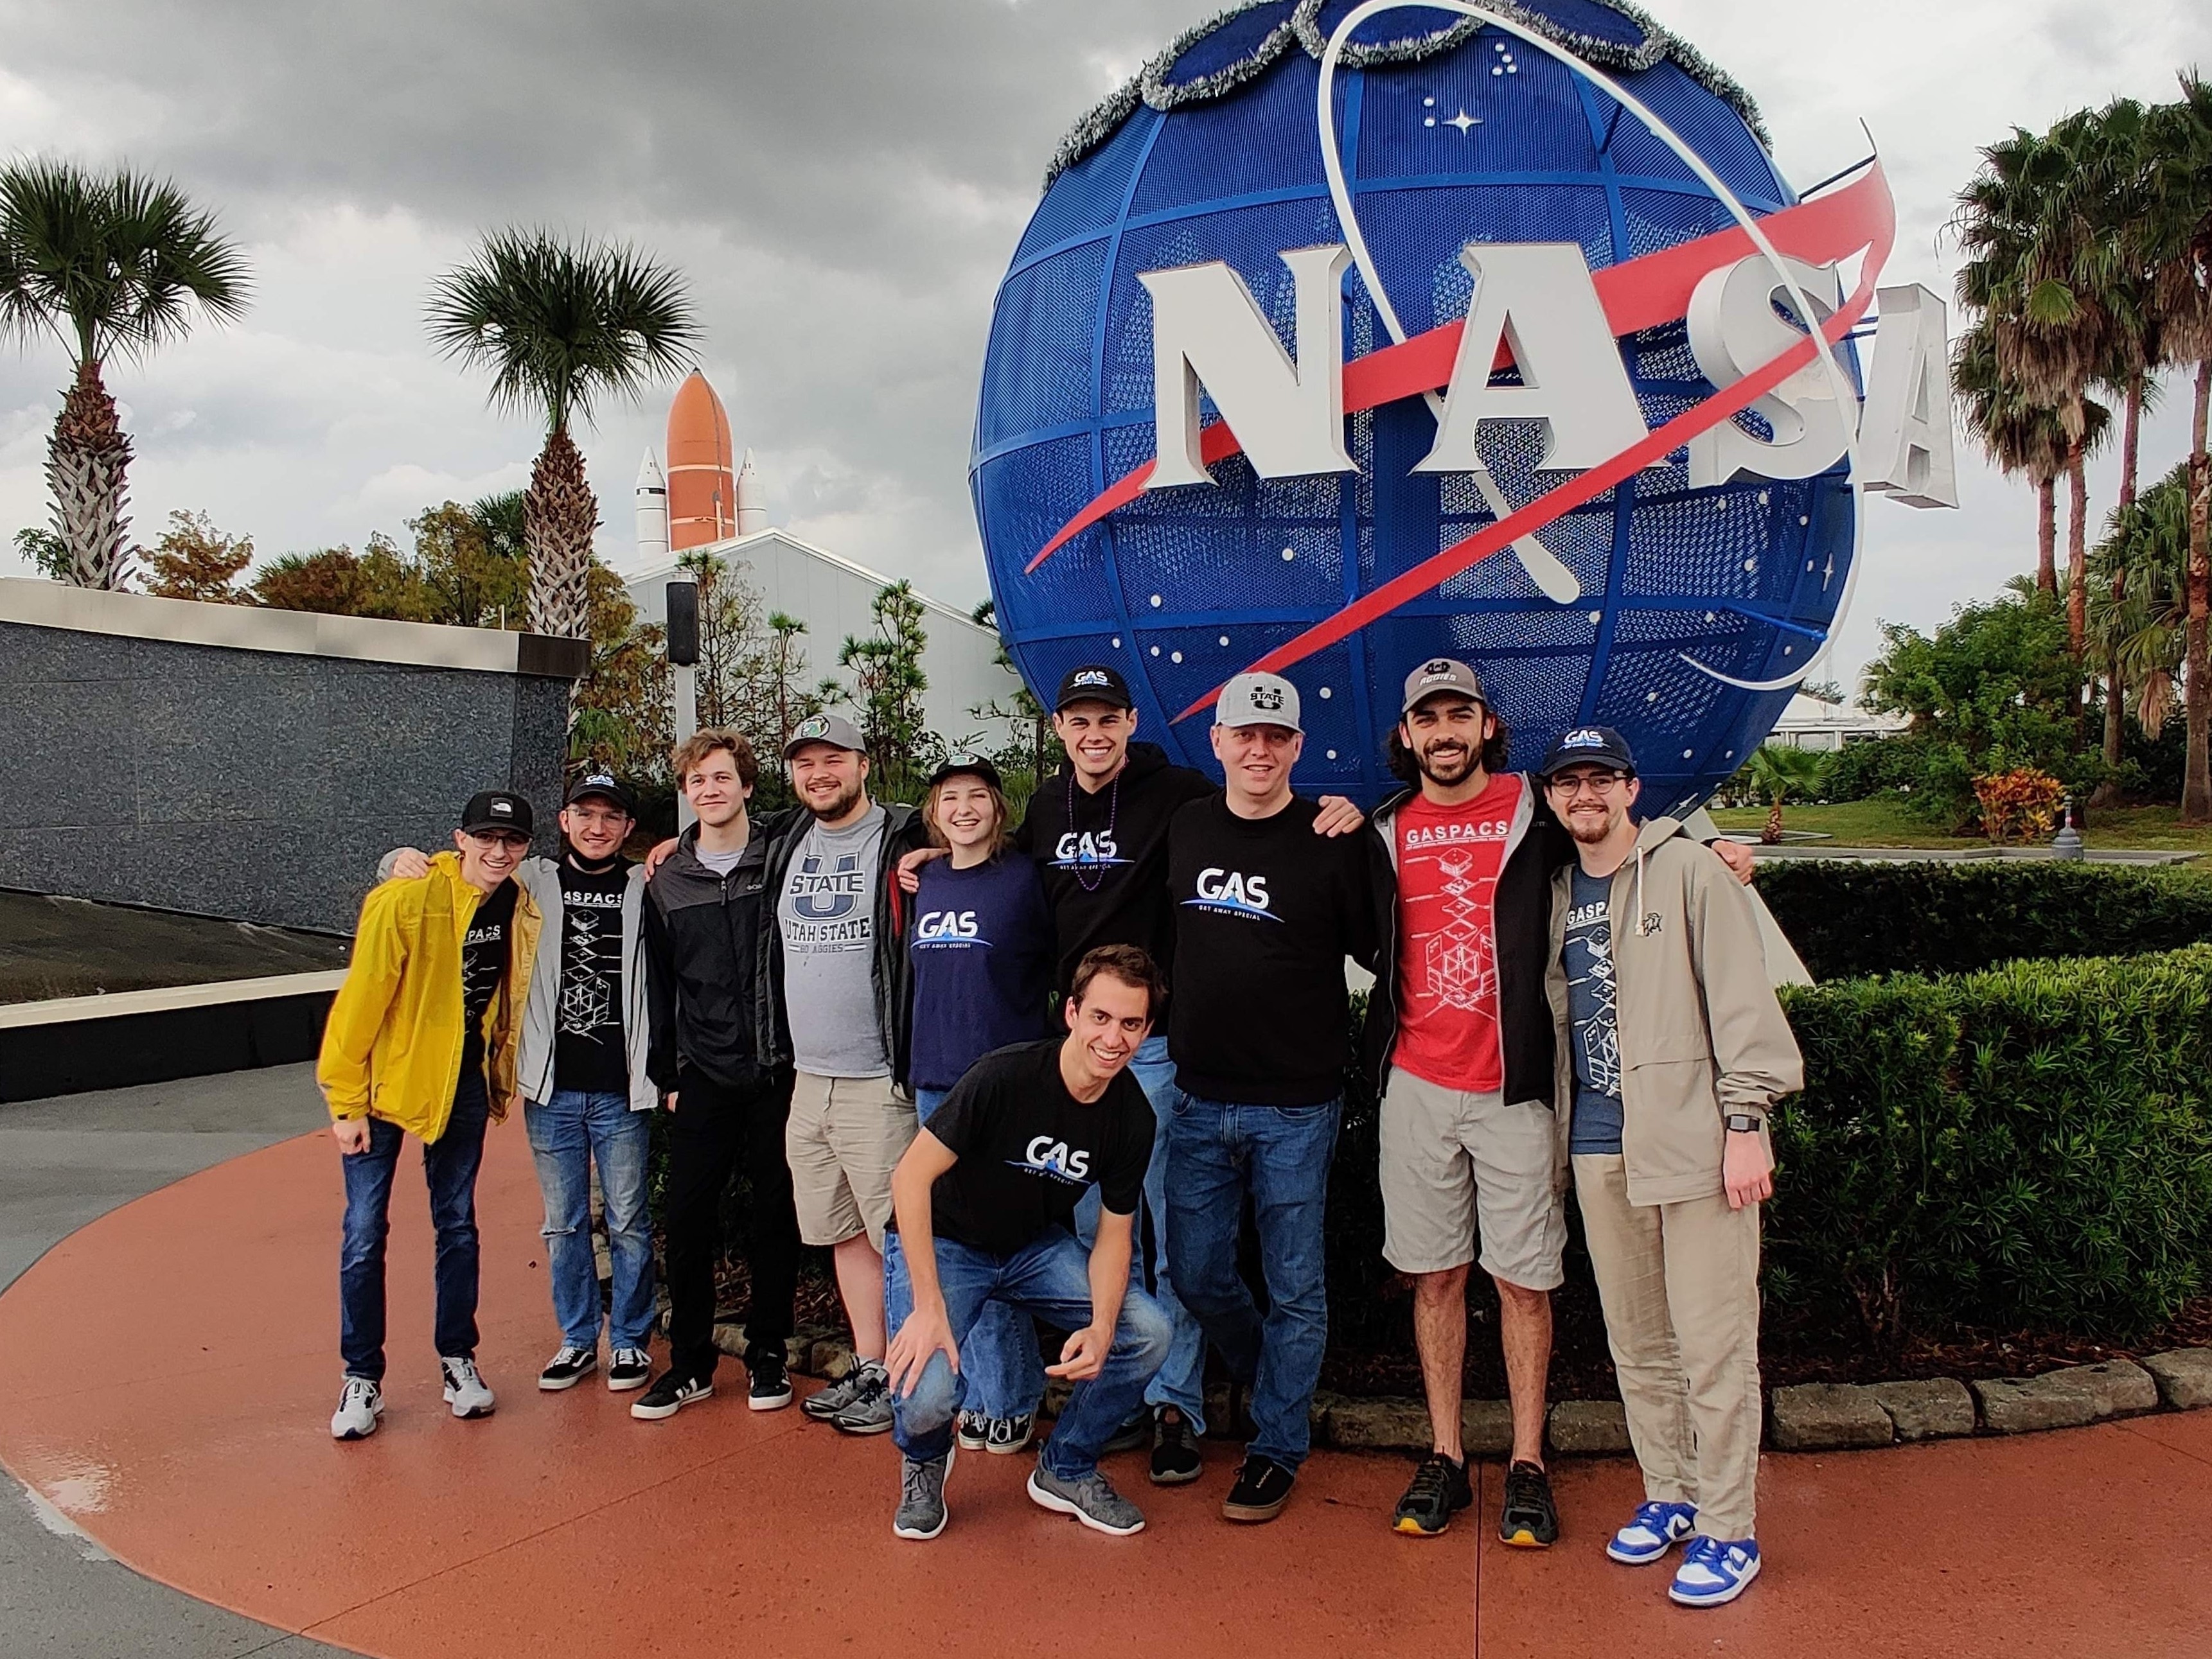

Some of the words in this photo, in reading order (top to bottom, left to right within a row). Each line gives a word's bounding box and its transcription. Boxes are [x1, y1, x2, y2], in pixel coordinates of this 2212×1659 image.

[1137, 241, 1958, 509] NASA
[1074, 671, 1108, 682] GAS
[1250, 692, 1284, 705] STATE
[1564, 730, 1604, 744] GAS
[1055, 829, 1117, 859] GAS
[1406, 820, 1508, 844] GASPACS
[790, 872, 864, 895] STATE
[1197, 868, 1270, 909] GAS
[563, 891, 623, 904] ASPACS
[918, 911, 978, 938] GAS
[1567, 901, 1609, 925] GASP
[468, 925, 500, 942] PACS
[784, 918, 817, 942] UTAH
[819, 917, 871, 942] STATE
[1026, 1136, 1090, 1179] GAS
